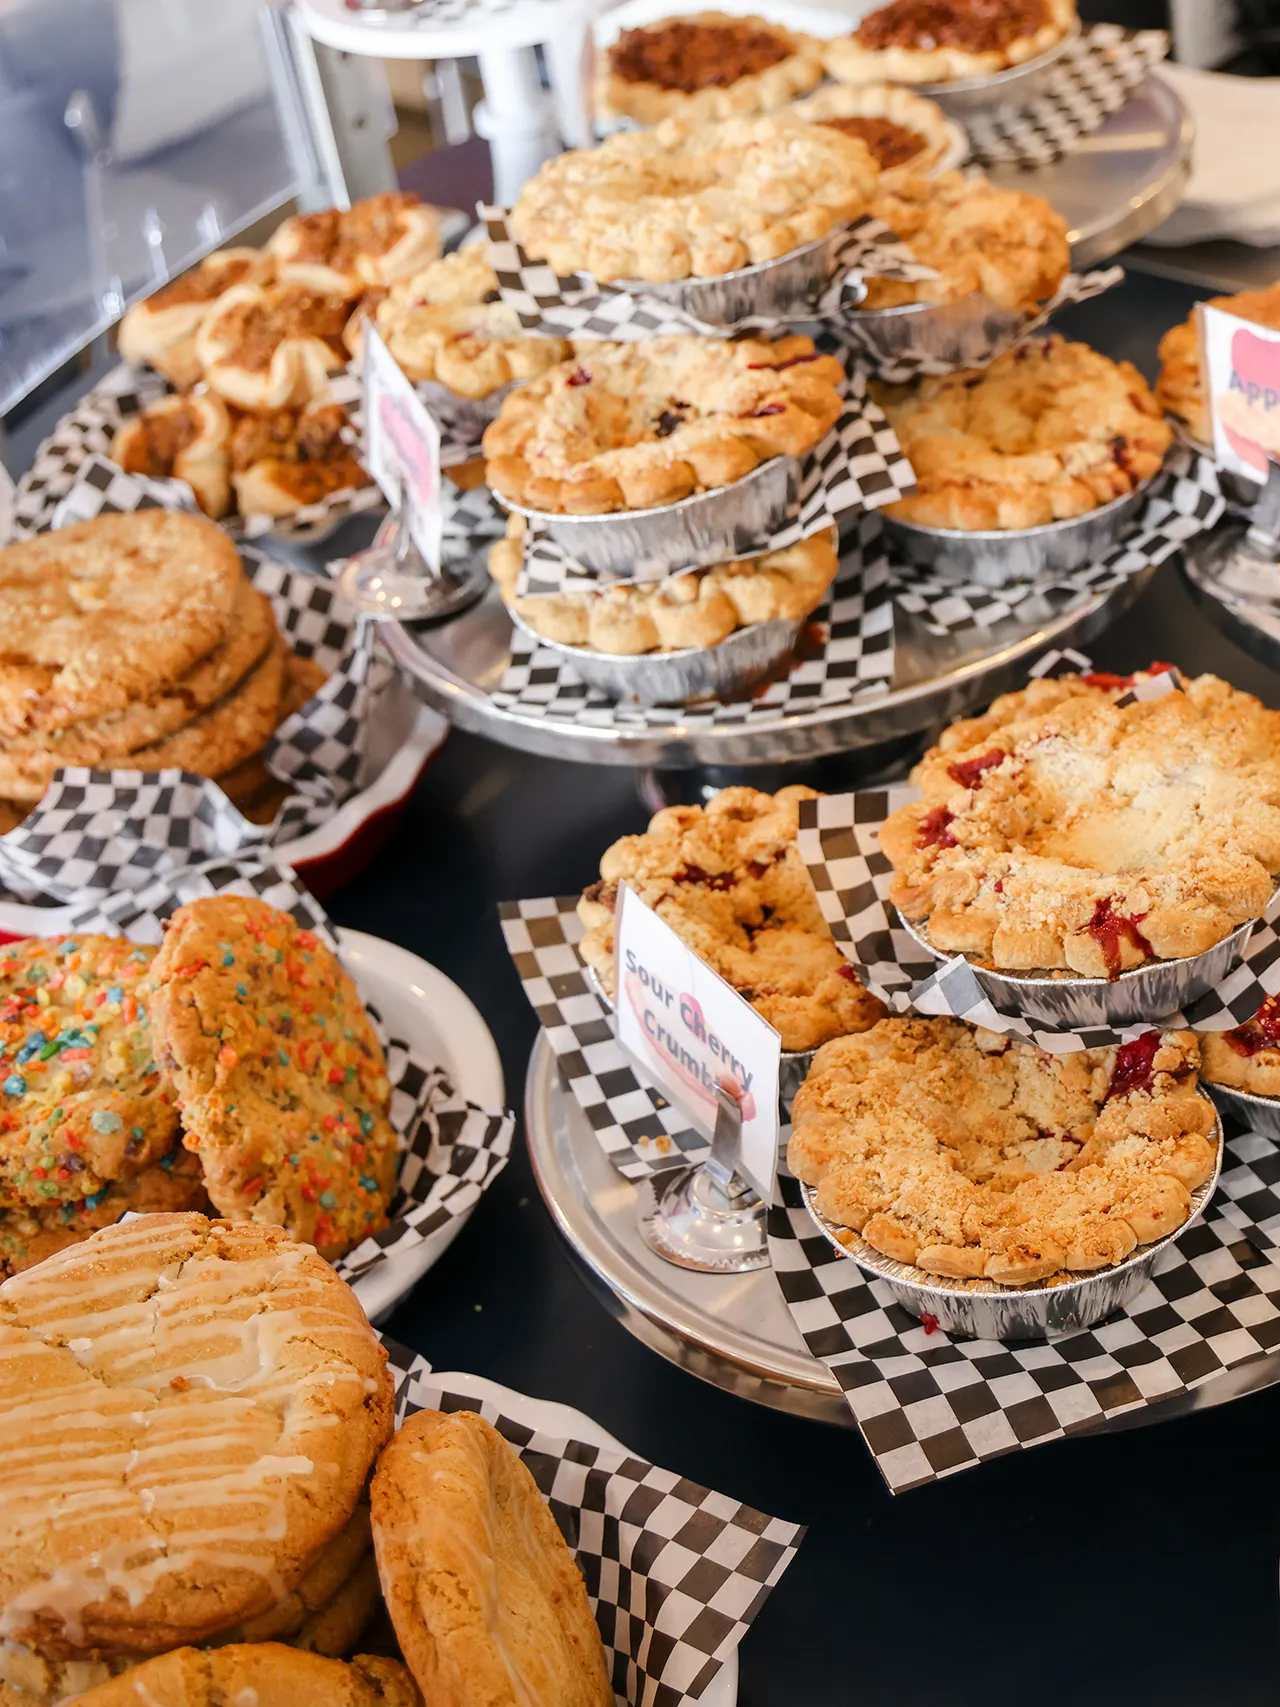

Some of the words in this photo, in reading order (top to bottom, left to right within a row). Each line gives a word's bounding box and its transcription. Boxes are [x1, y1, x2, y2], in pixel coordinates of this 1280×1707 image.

[625, 949, 674, 1009] Sour
[680, 1001, 754, 1092] Cherry
[644, 1008, 721, 1096] Crumbl
